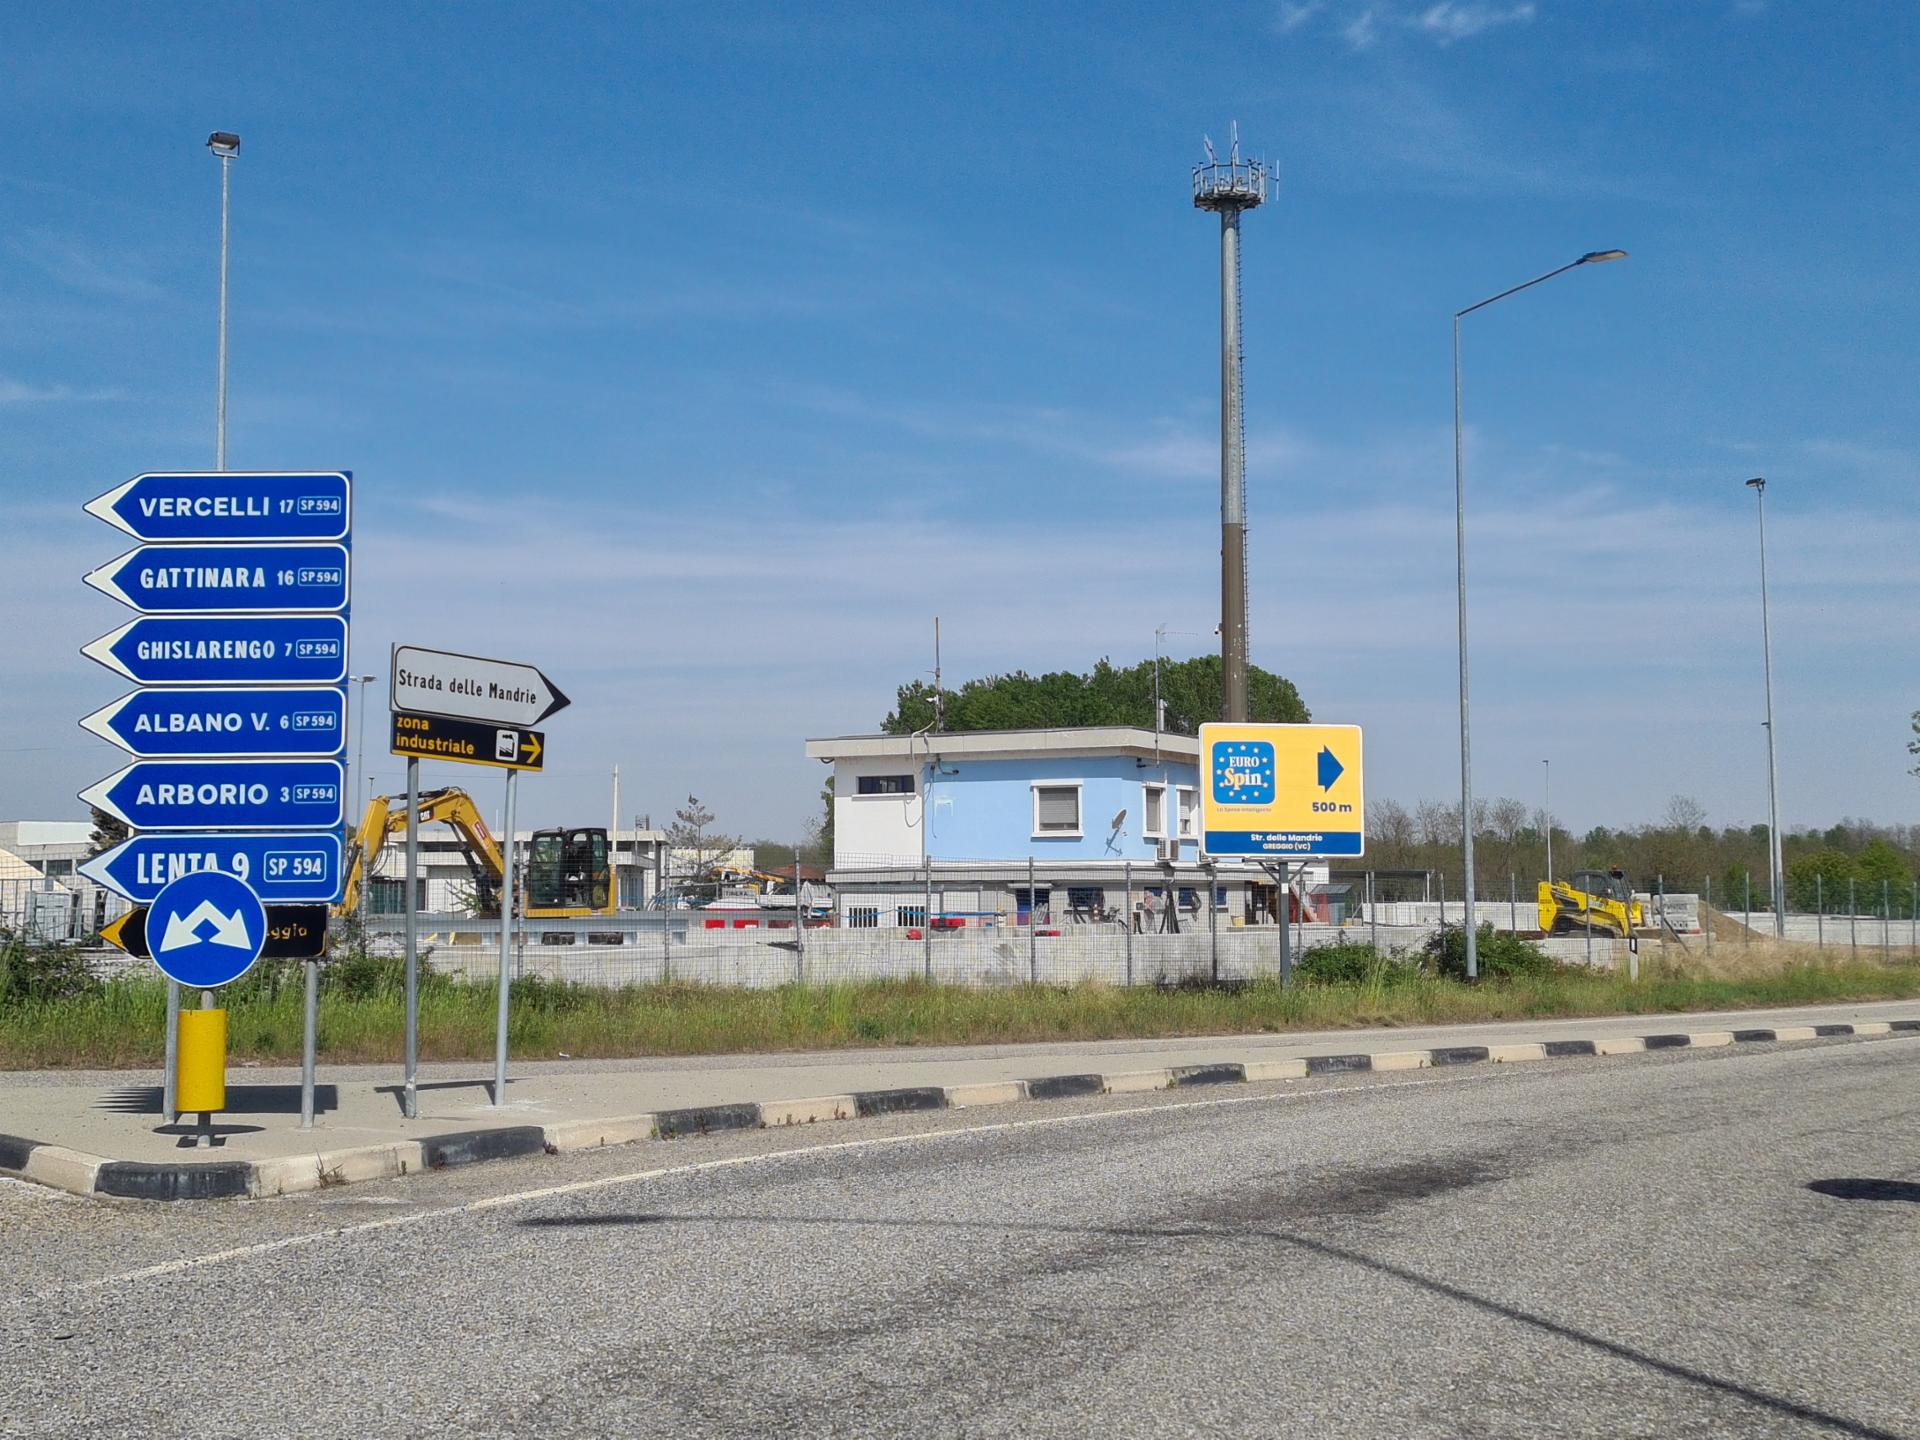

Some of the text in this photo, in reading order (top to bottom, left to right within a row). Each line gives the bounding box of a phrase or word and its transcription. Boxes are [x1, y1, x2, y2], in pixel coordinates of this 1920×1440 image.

[139, 497, 269, 517] VERCELLI
[279, 499, 294, 514] 17
[140, 567, 266, 588] GATTINARA
[277, 569, 294, 586] 16
[137, 640, 275, 660] GHISLARENGO
[284, 643, 292, 657] 7
[399, 669, 537, 704] Strada delle Mandrie
[134, 713, 243, 733] ALBANO
[251, 712, 270, 731] V.
[280, 715, 289, 729] 6
[397, 716, 430, 731] zona
[396, 733, 475, 755] industriale
[1229, 756, 1260, 768] EURO
[1224, 767, 1263, 791] Spin
[135, 784, 269, 805] ARBORIO
[280, 787, 290, 803] 3
[1312, 802, 1336, 812] 500
[1250, 833, 1323, 843] Str. delle Mandrie
[137, 852, 218, 884] LENTA
[232, 852, 250, 881] 9
